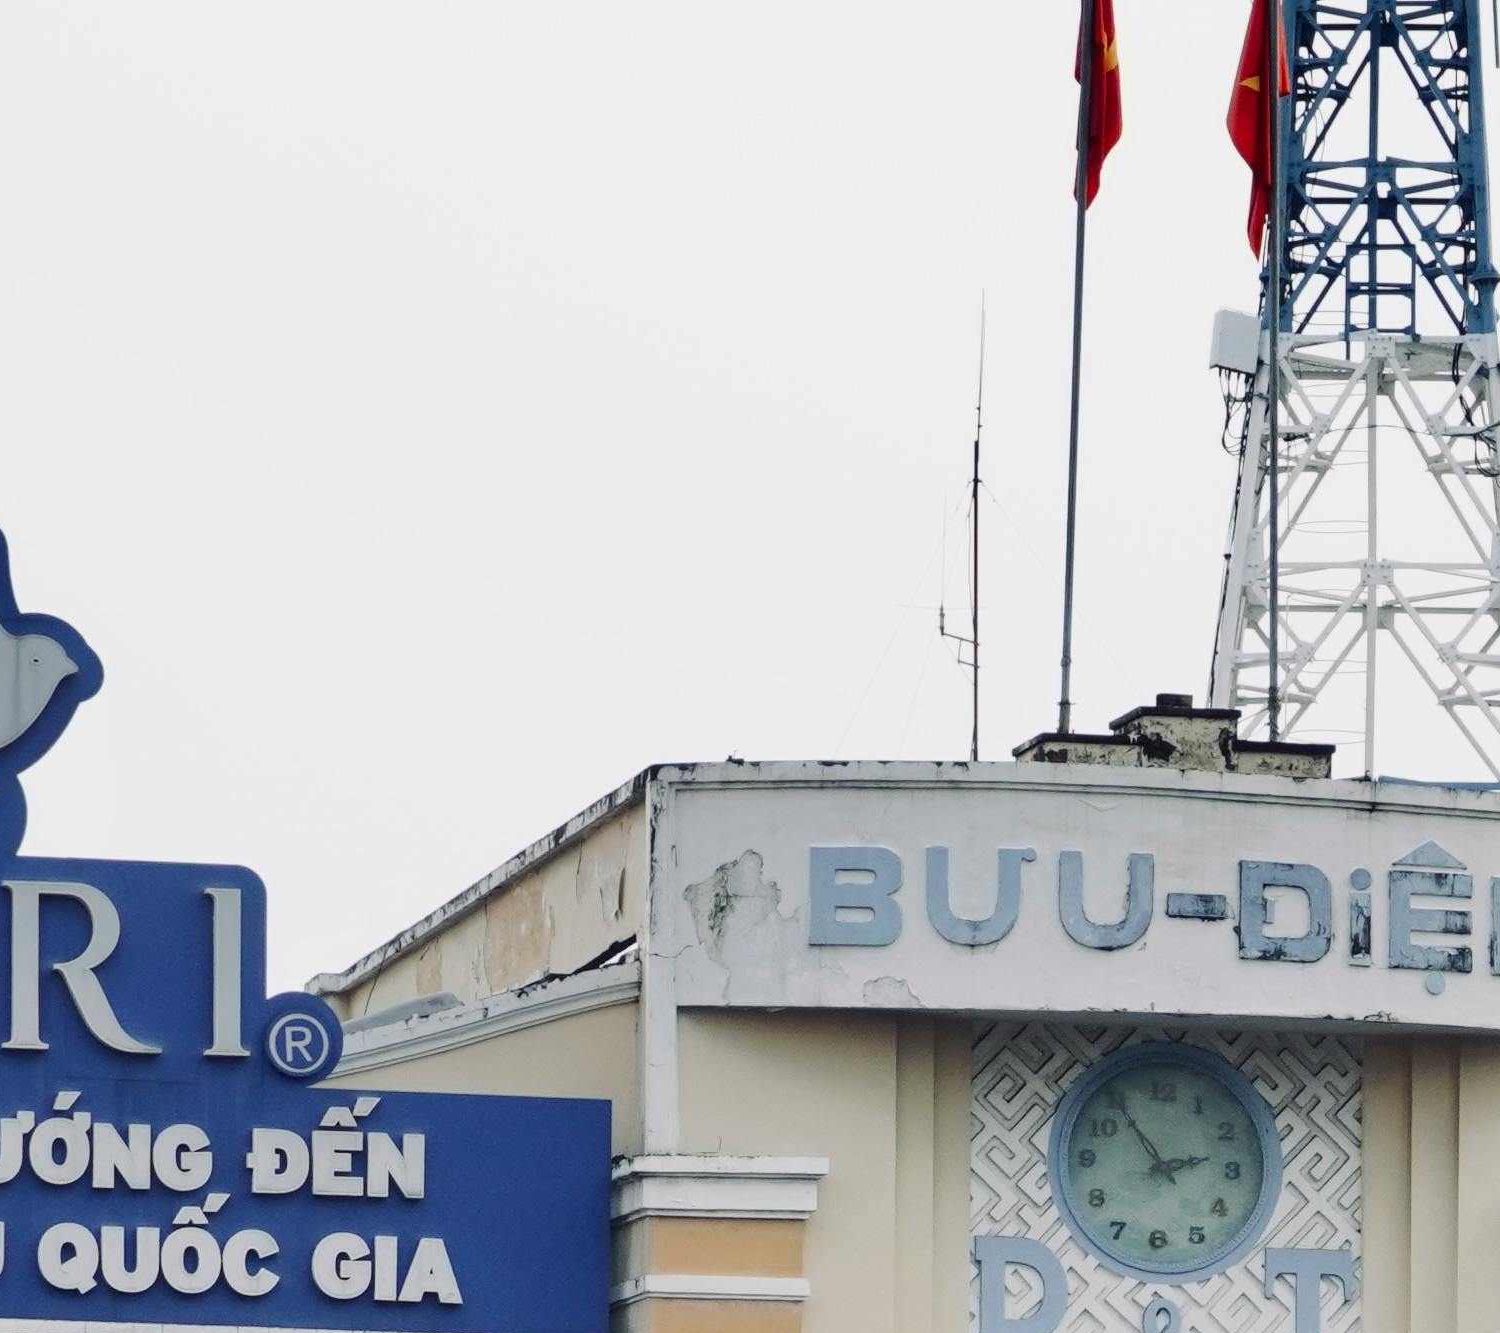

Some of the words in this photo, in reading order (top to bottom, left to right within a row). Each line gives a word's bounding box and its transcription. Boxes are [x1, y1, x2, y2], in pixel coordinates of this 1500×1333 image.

[246, 1096, 426, 1200] ĐẾN
[37, 1193, 280, 1297] QUỐC
[311, 1230, 463, 1306] GIA
